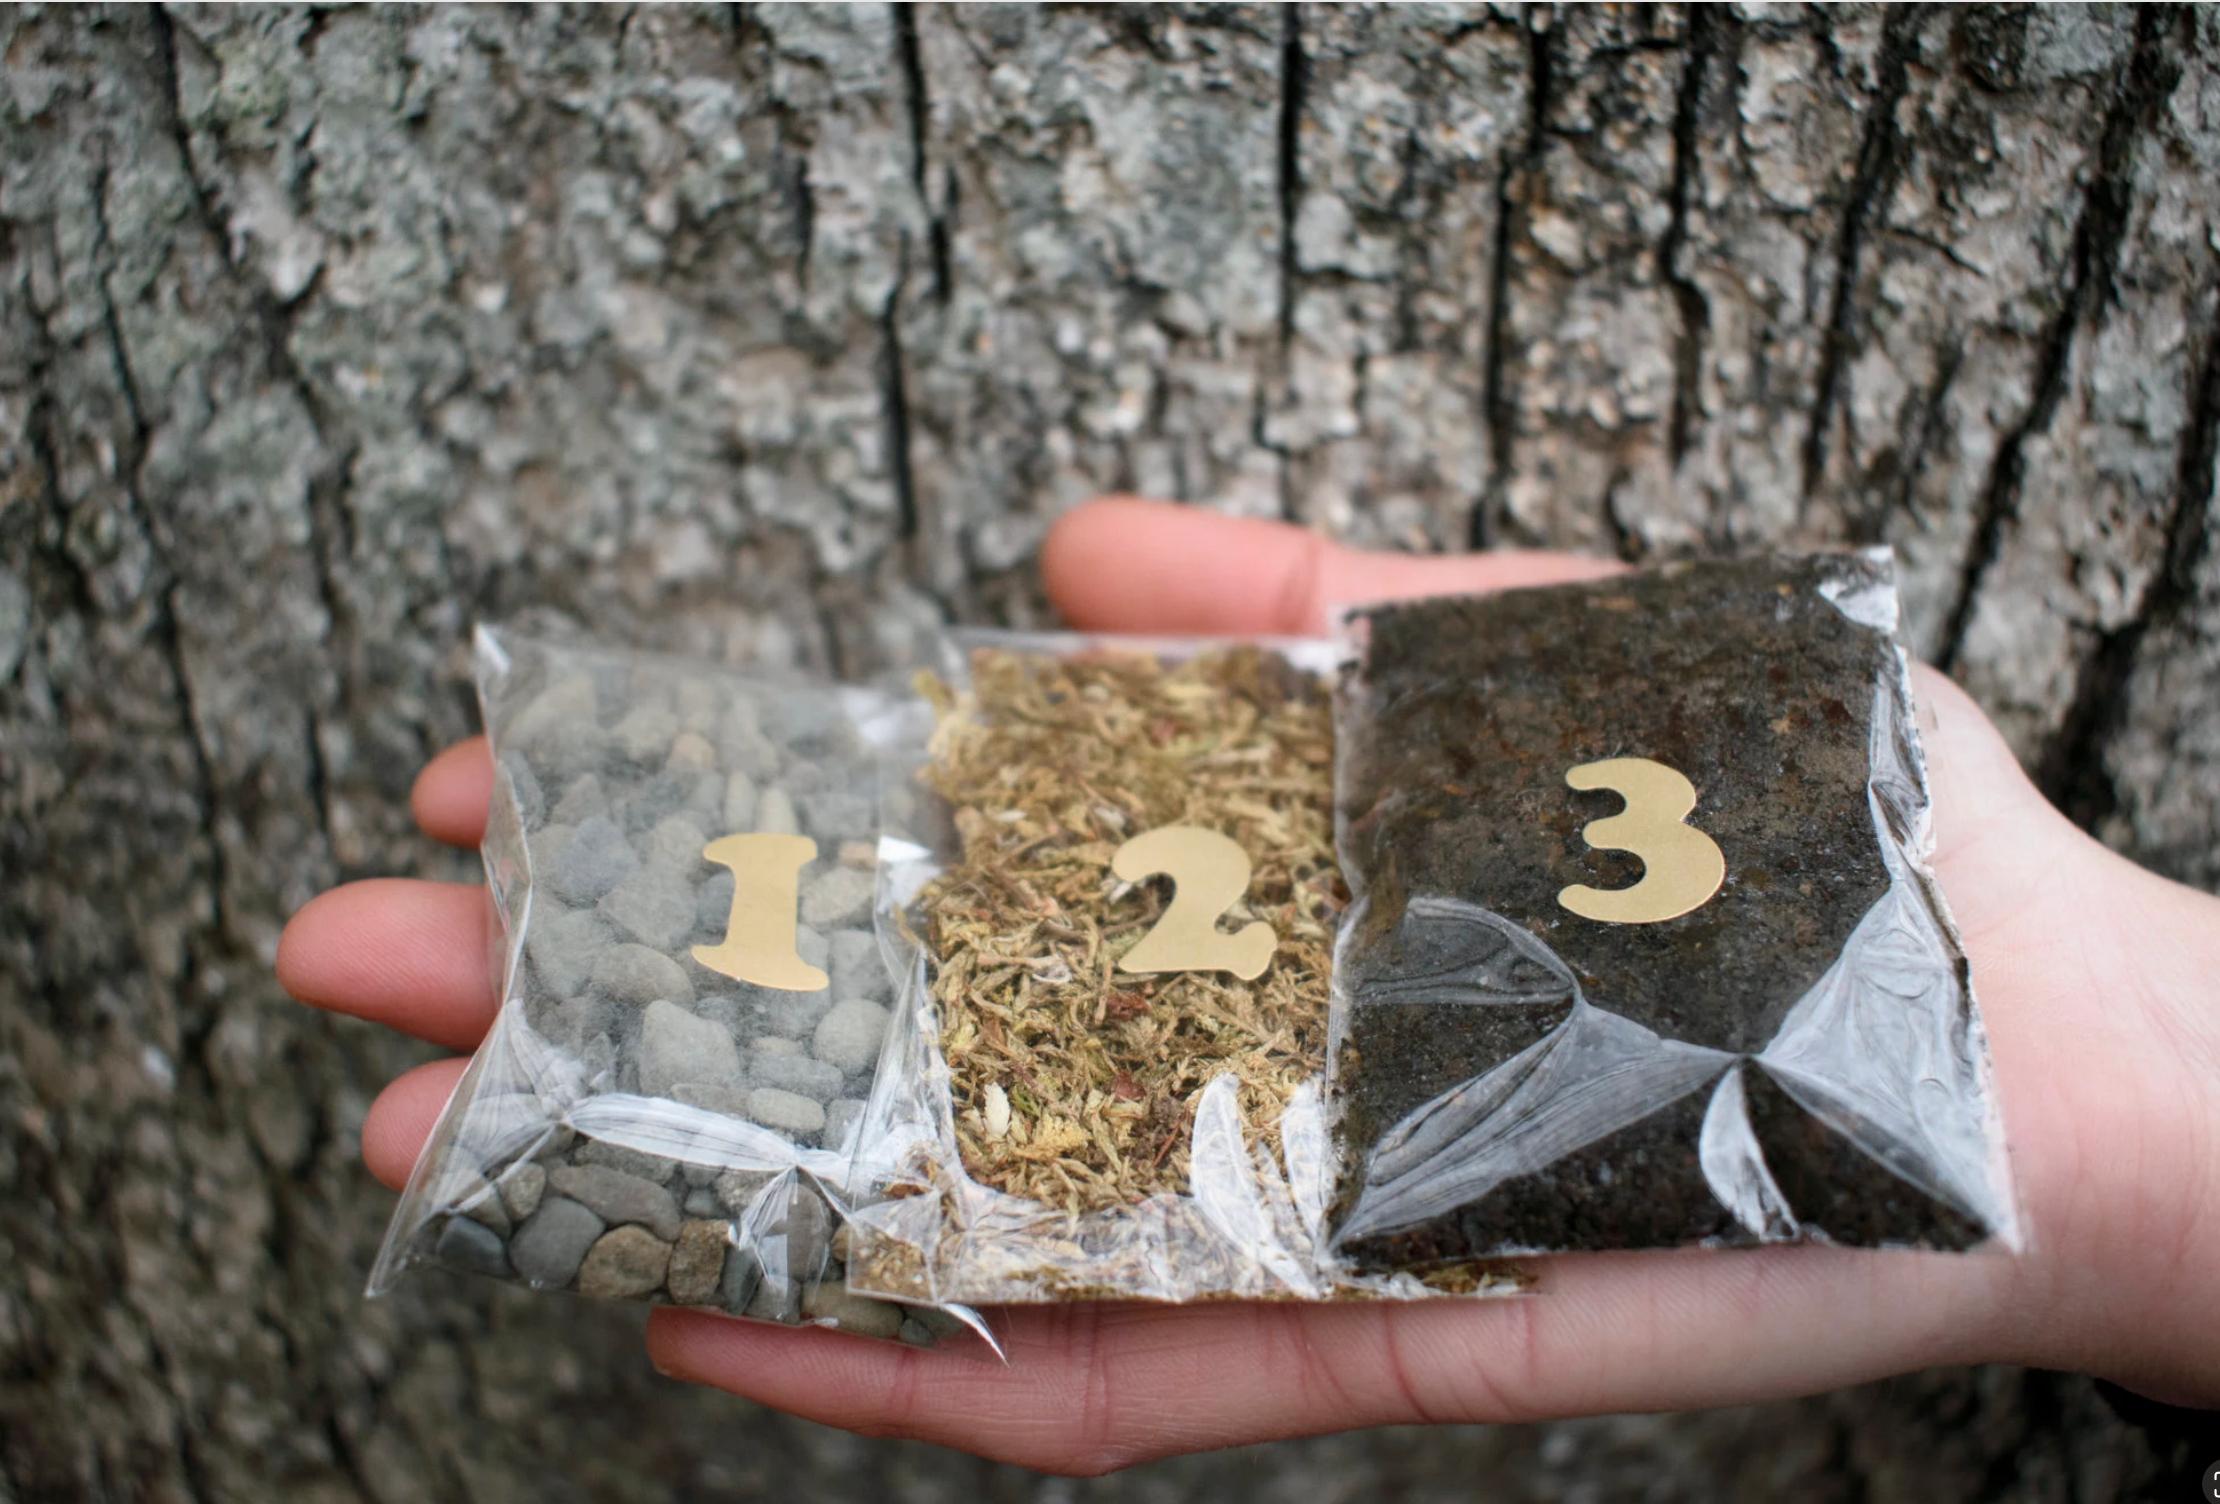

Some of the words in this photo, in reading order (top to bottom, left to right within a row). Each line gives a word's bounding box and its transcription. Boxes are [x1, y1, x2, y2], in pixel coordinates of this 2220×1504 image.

[691, 832, 829, 991] 1
[1112, 826, 1277, 980] 2
[1557, 758, 1726, 924] 3
